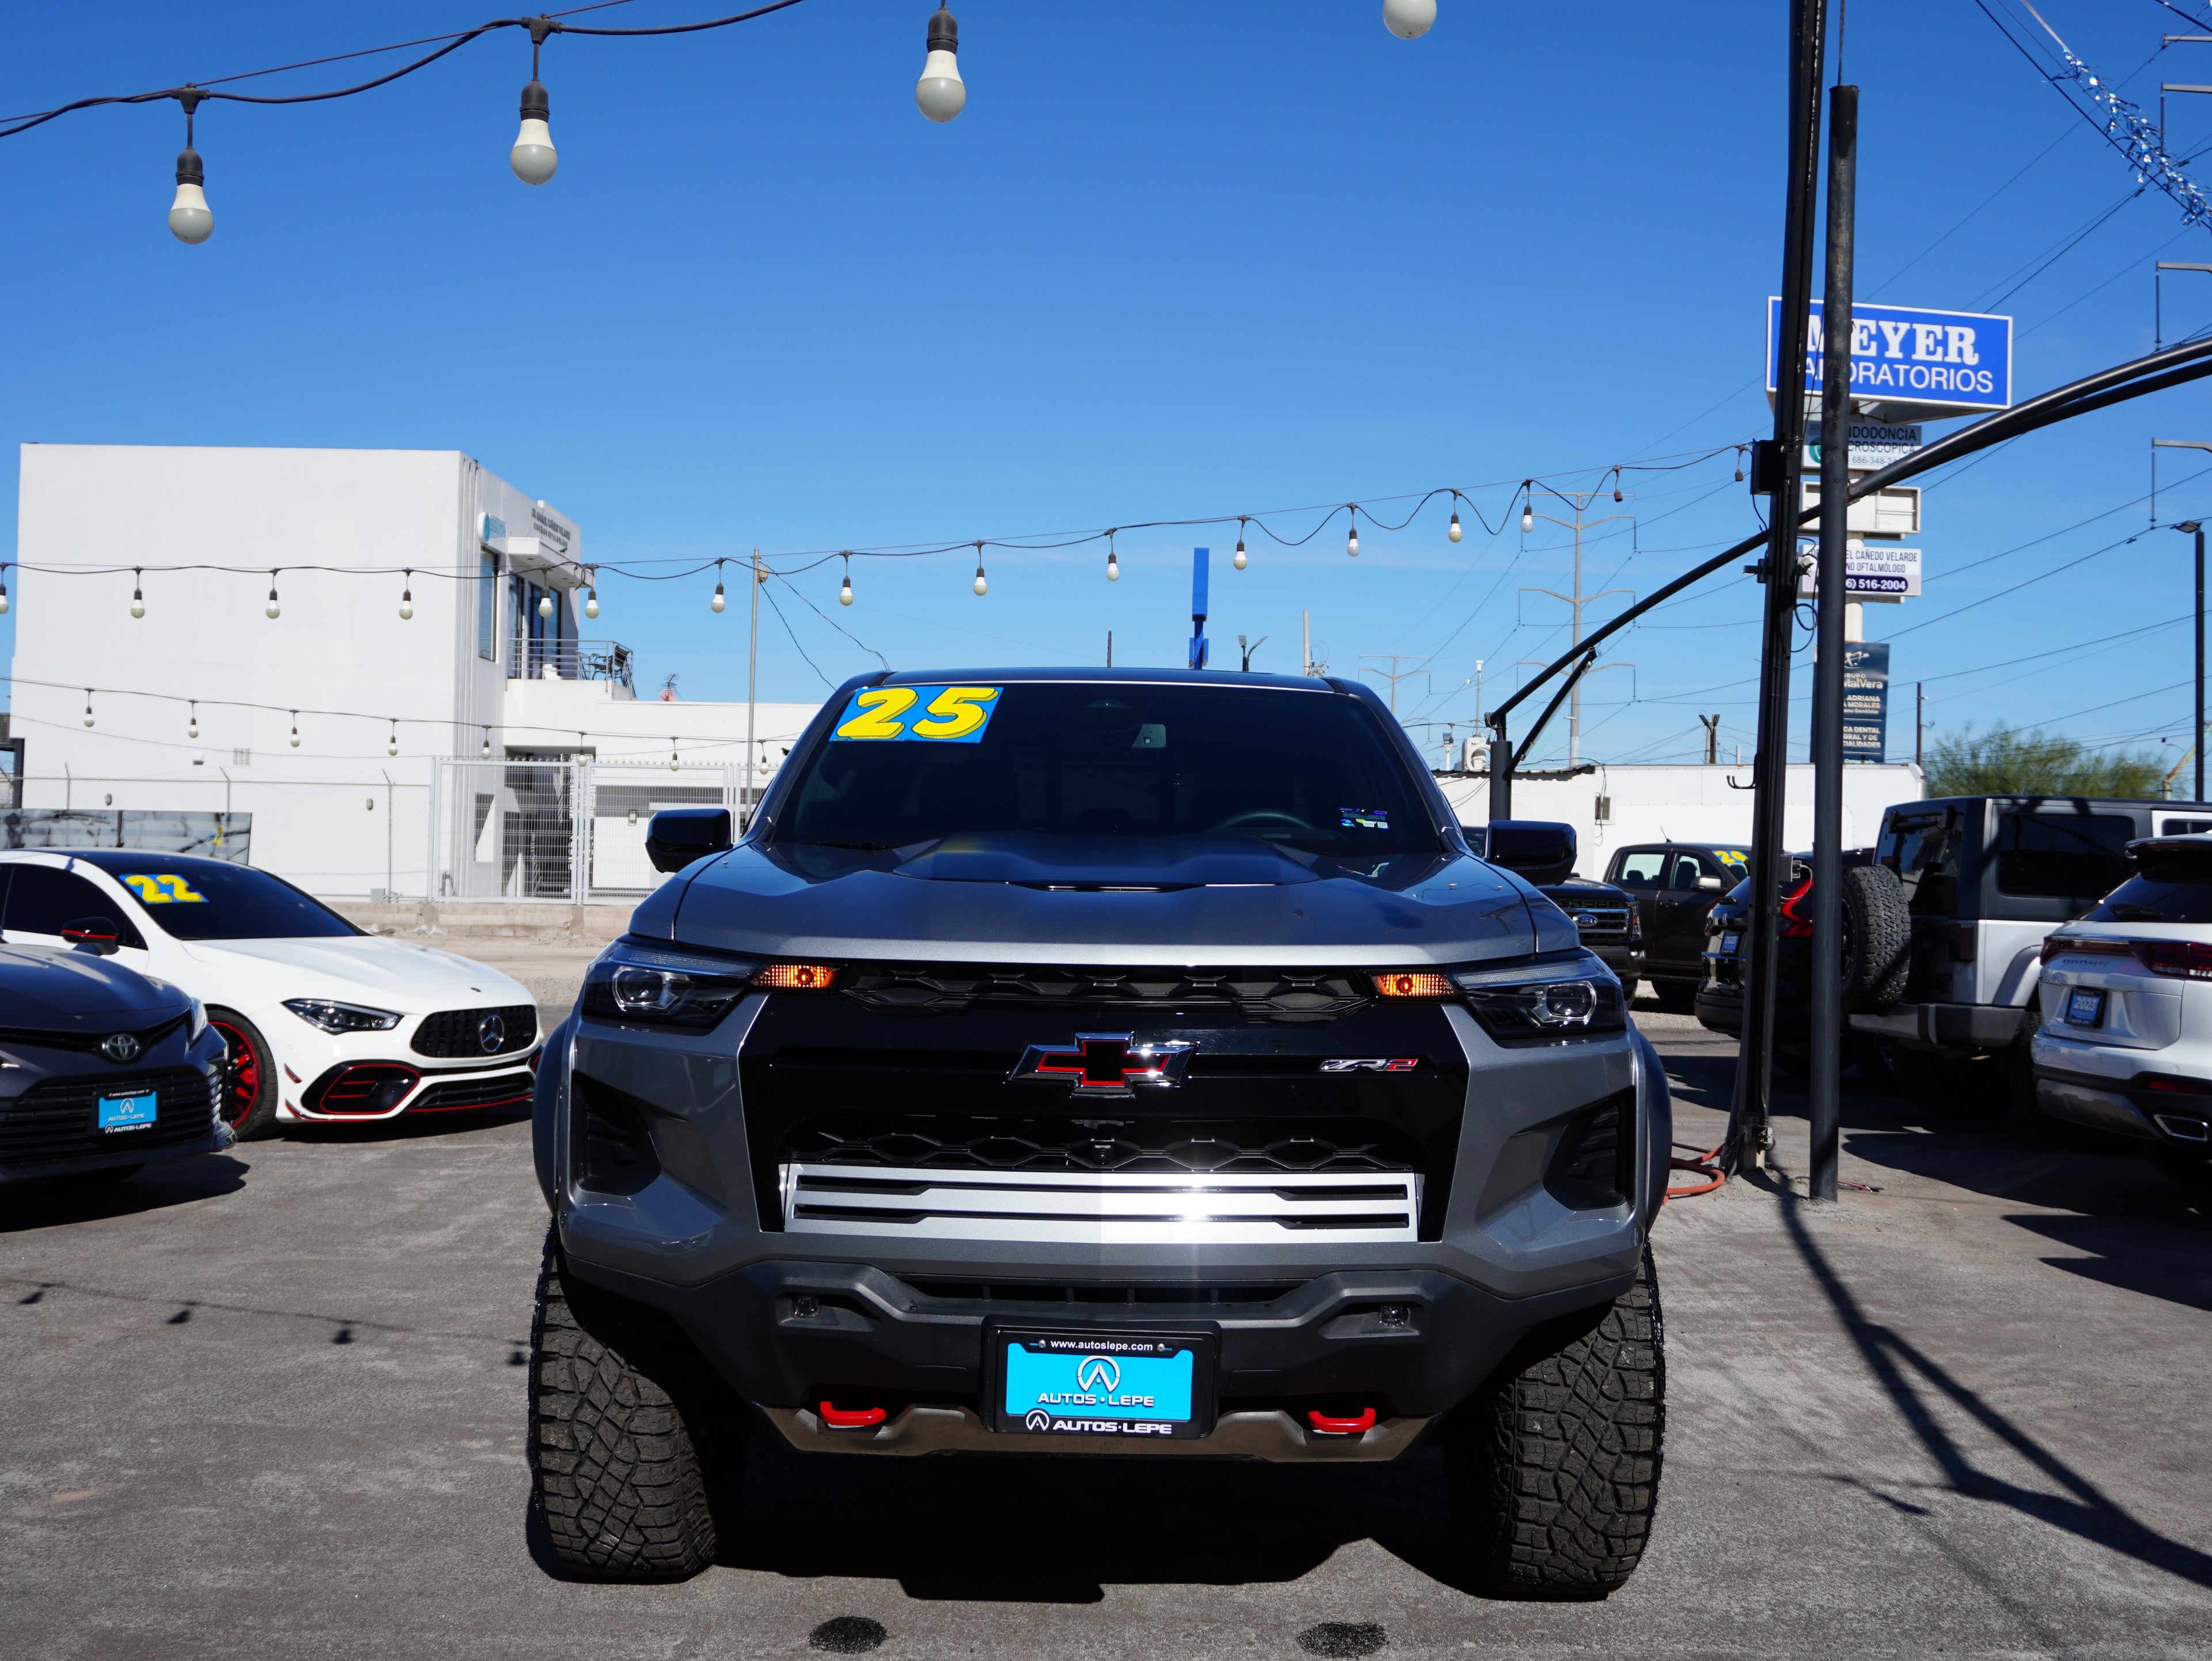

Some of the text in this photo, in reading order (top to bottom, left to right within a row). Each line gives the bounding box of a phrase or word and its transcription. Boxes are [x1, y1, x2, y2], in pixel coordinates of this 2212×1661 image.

[1805, 357, 1993, 393] ARATORIOS
[1849, 426, 1916, 441] DODONCIA
[1848, 441, 1915, 454] CROSCOPICA
[1856, 549, 1884, 561] CAÑEDO
[1886, 553, 1918, 562] VELARDE
[1857, 562, 1906, 573] OFTALMÓLOGO
[1858, 579, 1906, 590] 516-2004
[836, 687, 999, 740] 25
[125, 875, 203, 902] 22
[2074, 996, 2097, 1012] 2023
[1317, 1059, 1418, 1072] ZR2
[1051, 1341, 1153, 1351] www.autoslepe.com
[1108, 1395, 1154, 1406] LEPE
